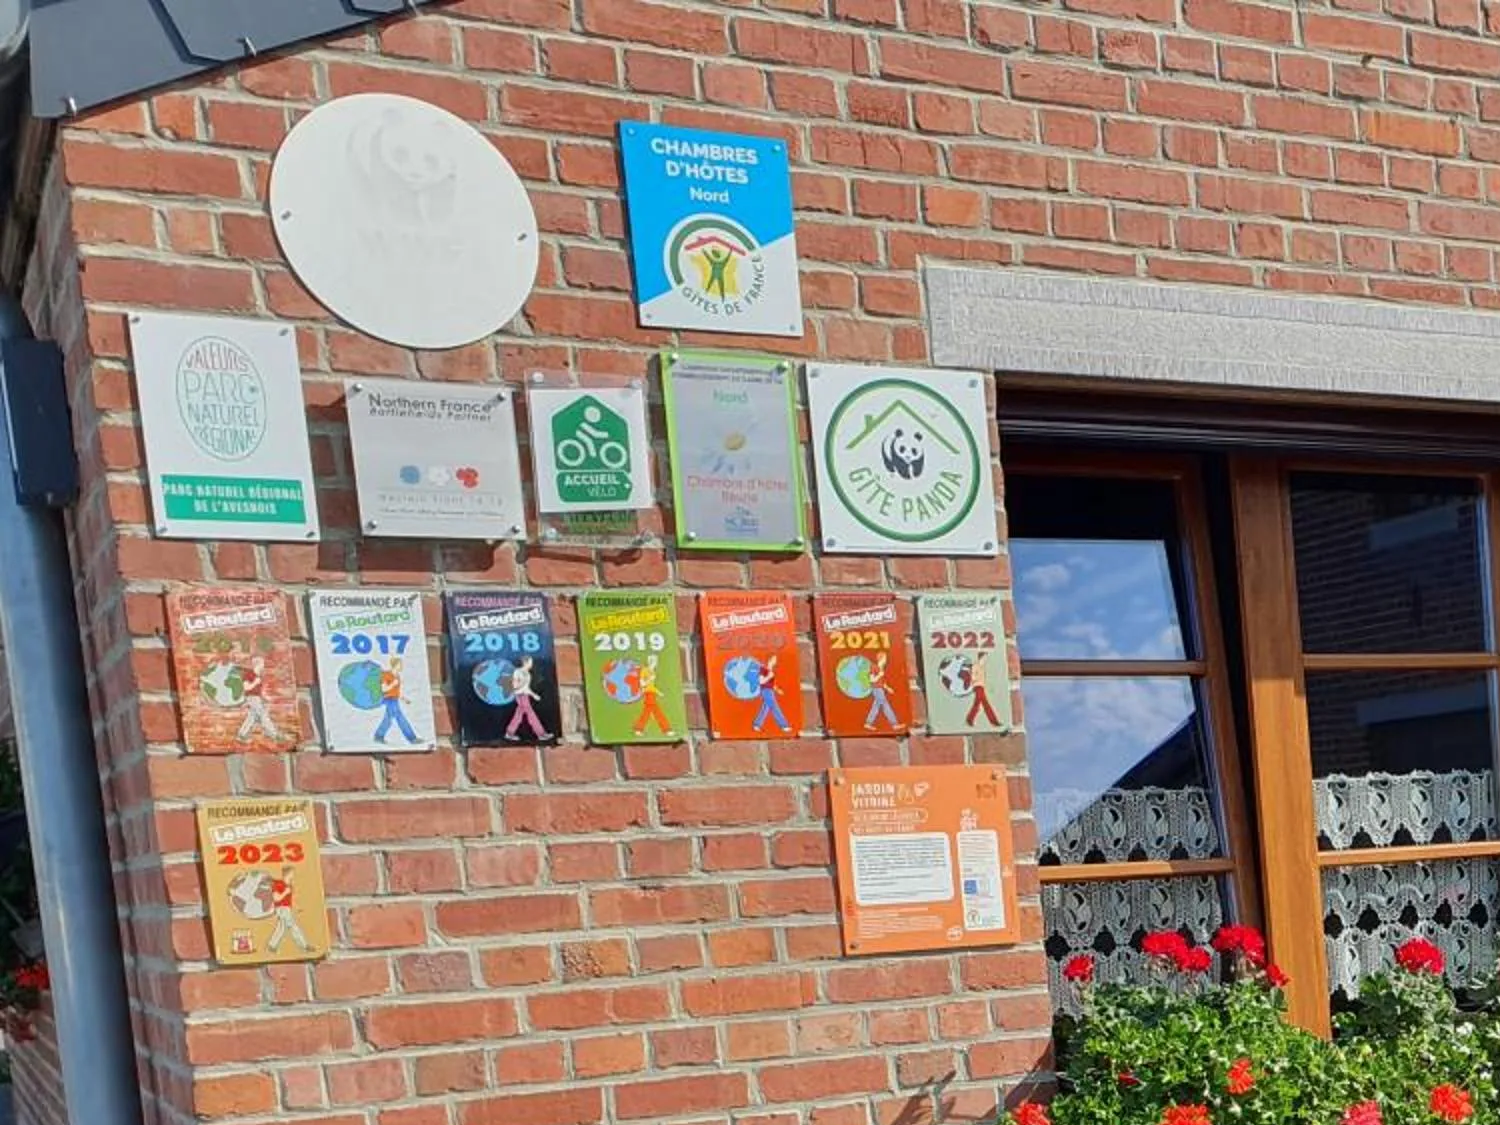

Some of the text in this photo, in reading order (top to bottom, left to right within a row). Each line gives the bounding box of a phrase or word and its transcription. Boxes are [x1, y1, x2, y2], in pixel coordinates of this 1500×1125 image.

[651, 137, 759, 165] CHAMBRES
[665, 159, 748, 184] D'HÔTES
[689, 187, 730, 204] Nord
[724, 302, 744, 316] DE
[744, 255, 766, 305] FRANCE
[183, 370, 259, 404] PARC
[368, 393, 492, 413] Northern France
[188, 403, 260, 427] NATUREL
[564, 473, 621, 487] ACCUEIL
[163, 483, 193, 497] PARC
[196, 485, 246, 499] NATUREL
[901, 470, 963, 522] PANDA
[194, 499, 209, 513] DE
[206, 607, 273, 627] Routard
[345, 610, 411, 628] Routard
[479, 607, 540, 627] Routard
[730, 607, 785, 625] Routard
[841, 607, 893, 626] Routard
[331, 633, 411, 655] 2017
[464, 631, 540, 652] 2018
[594, 631, 665, 651] 2019
[829, 631, 891, 649] 2021
[931, 631, 995, 649] 2022
[852, 783, 895, 796] JARDIN
[852, 797, 897, 809] VITRINE
[236, 815, 303, 836] Routard
[217, 842, 305, 865] 2023
